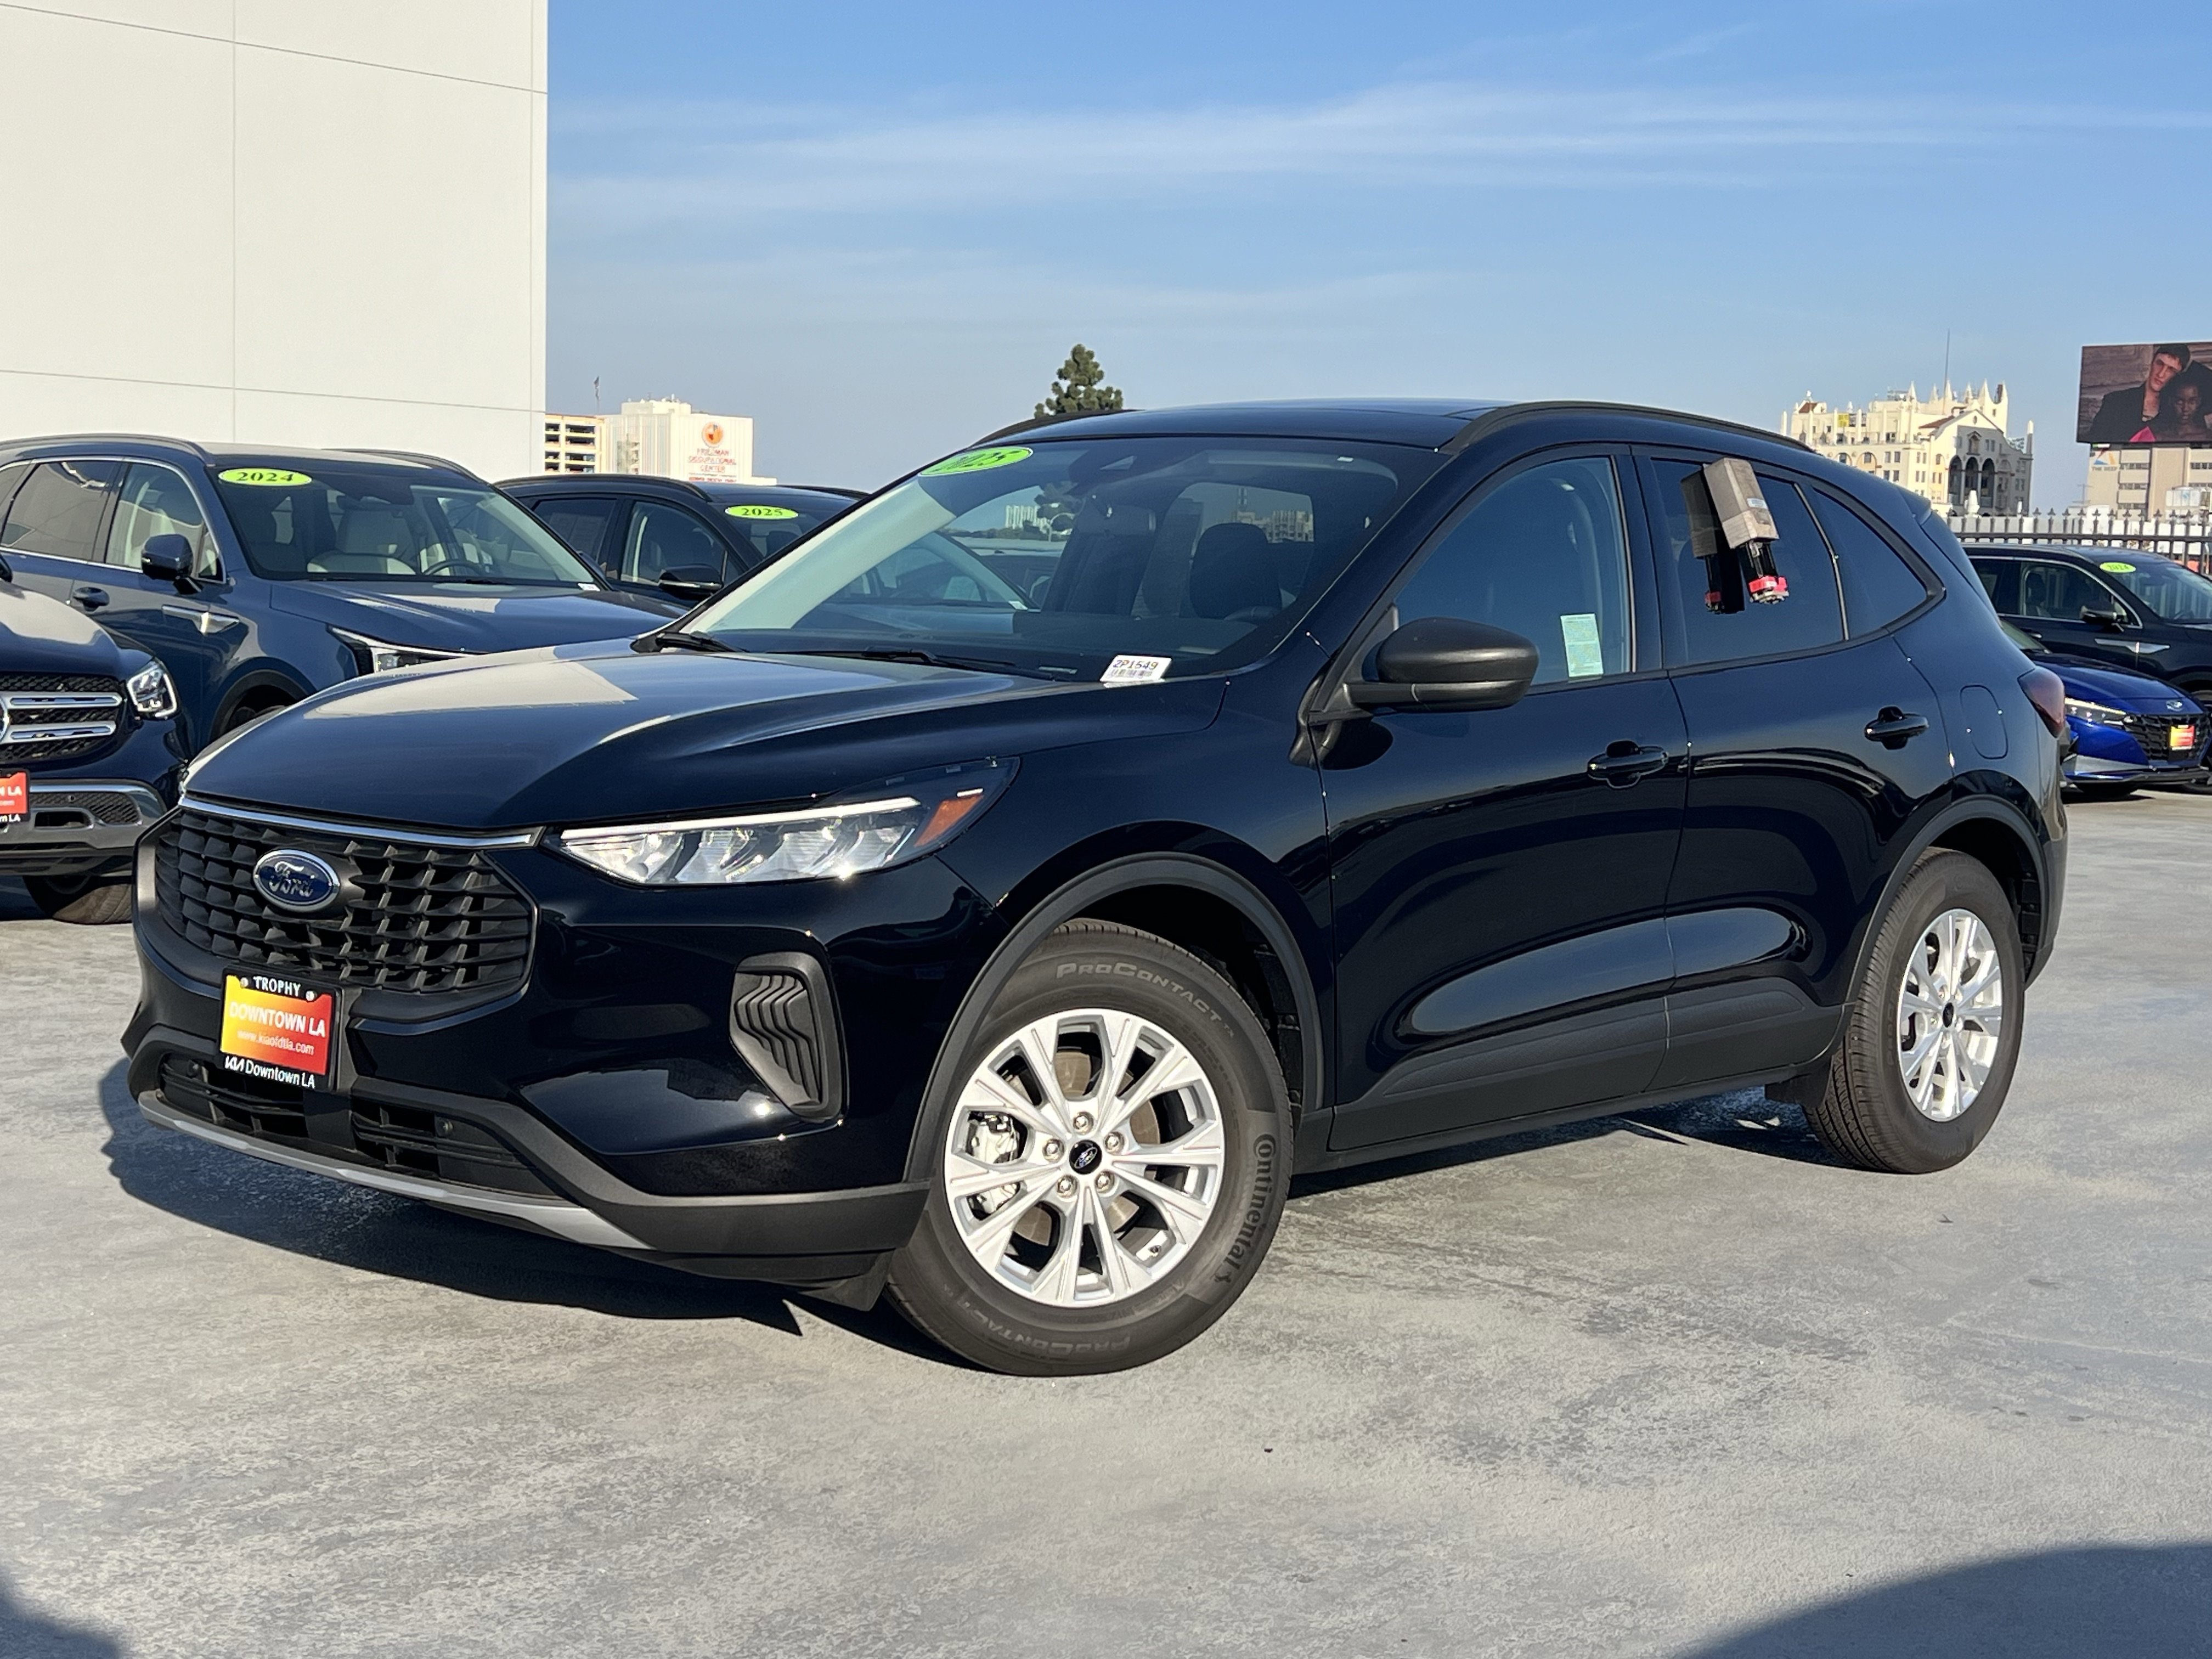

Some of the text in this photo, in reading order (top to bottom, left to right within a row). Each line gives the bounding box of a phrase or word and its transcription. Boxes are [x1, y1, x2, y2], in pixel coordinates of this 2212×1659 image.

[236, 472, 294, 482] 2024
[741, 508, 783, 517] 2025
[7, 786, 22, 797] LA
[9, 814, 21, 822] LA
[268, 861, 313, 898] Ford
[253, 975, 301, 996] TROPHY
[229, 1001, 326, 1038] DOWNTOWN LA
[245, 1059, 300, 1086] Downtown
[301, 1072, 315, 1089] LA
[1211, 1133, 1277, 1270] Continental
